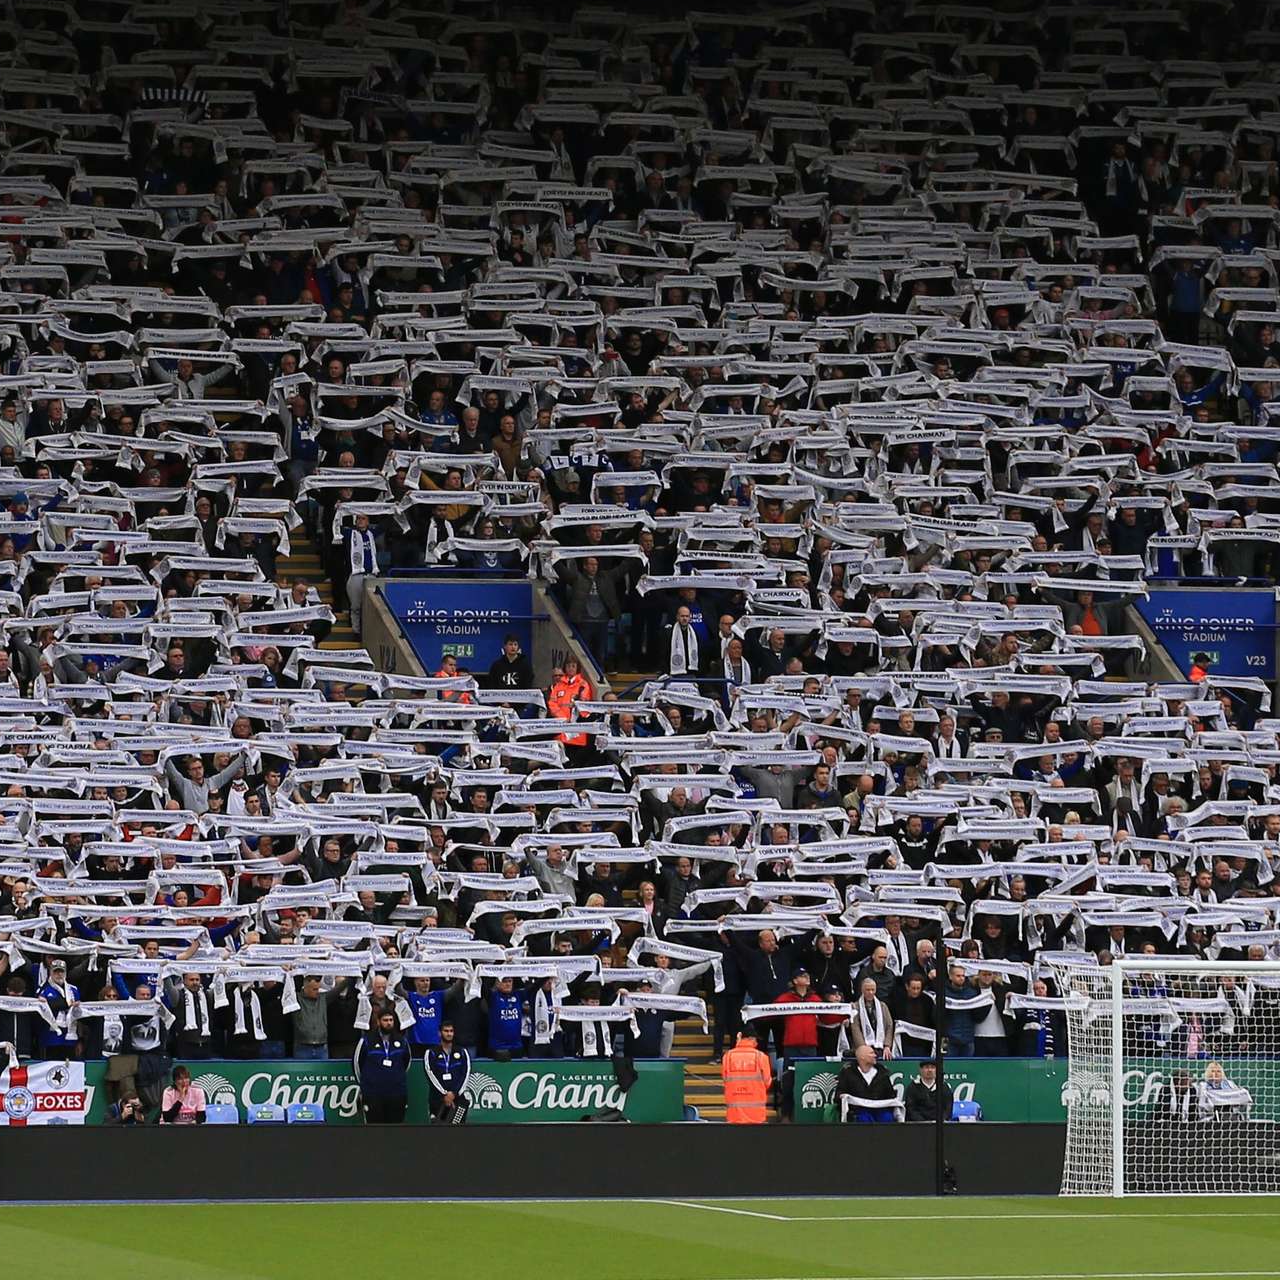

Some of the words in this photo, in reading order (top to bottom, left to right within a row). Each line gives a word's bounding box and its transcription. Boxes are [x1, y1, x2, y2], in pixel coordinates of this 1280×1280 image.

[407, 609, 448, 623] KING
[453, 609, 510, 623] POWER
[1155, 617, 1195, 630] KING
[1200, 617, 1254, 631] POWER
[435, 625, 481, 634] STADIUM
[1182, 632, 1226, 642] STADIUM
[1246, 655, 1266, 666] V23
[16, 734, 57, 742] CHAIRMAN
[418, 1006, 435, 1014] KING
[500, 1007, 519, 1016] KING
[500, 1013, 519, 1021] POWER
[241, 1072, 360, 1117] Chang
[507, 1071, 627, 1113] Chang
[36, 1095, 82, 1109] FOXES
